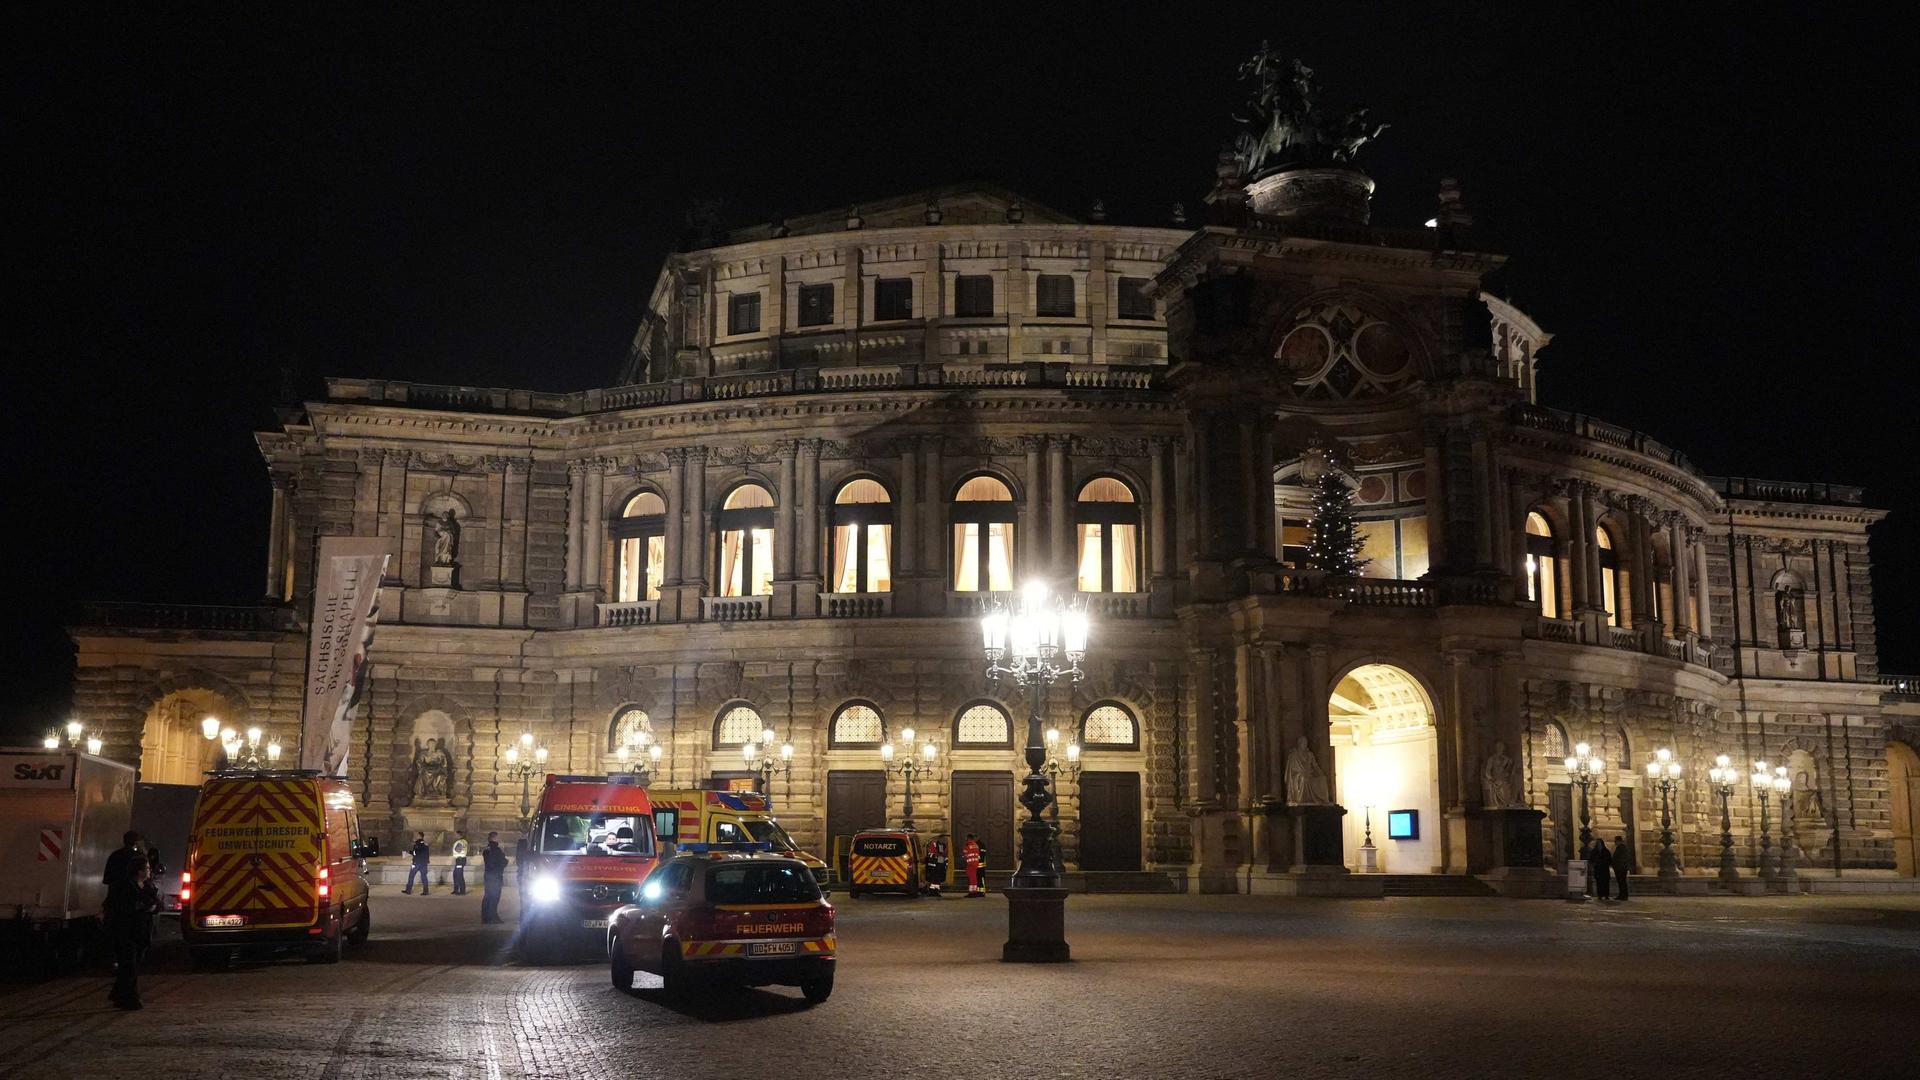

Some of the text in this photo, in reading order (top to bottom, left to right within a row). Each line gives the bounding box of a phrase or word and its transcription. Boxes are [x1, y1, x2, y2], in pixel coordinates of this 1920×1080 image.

[315, 592, 339, 695] SÄCHSISCHE
[553, 803, 640, 812] EINSATZLEITUNG
[205, 826, 310, 837] FEUERWEHR DRESDEN
[218, 840, 295, 849] UMWELTSCHUTZ
[736, 923, 804, 934] FEUERWEHR
